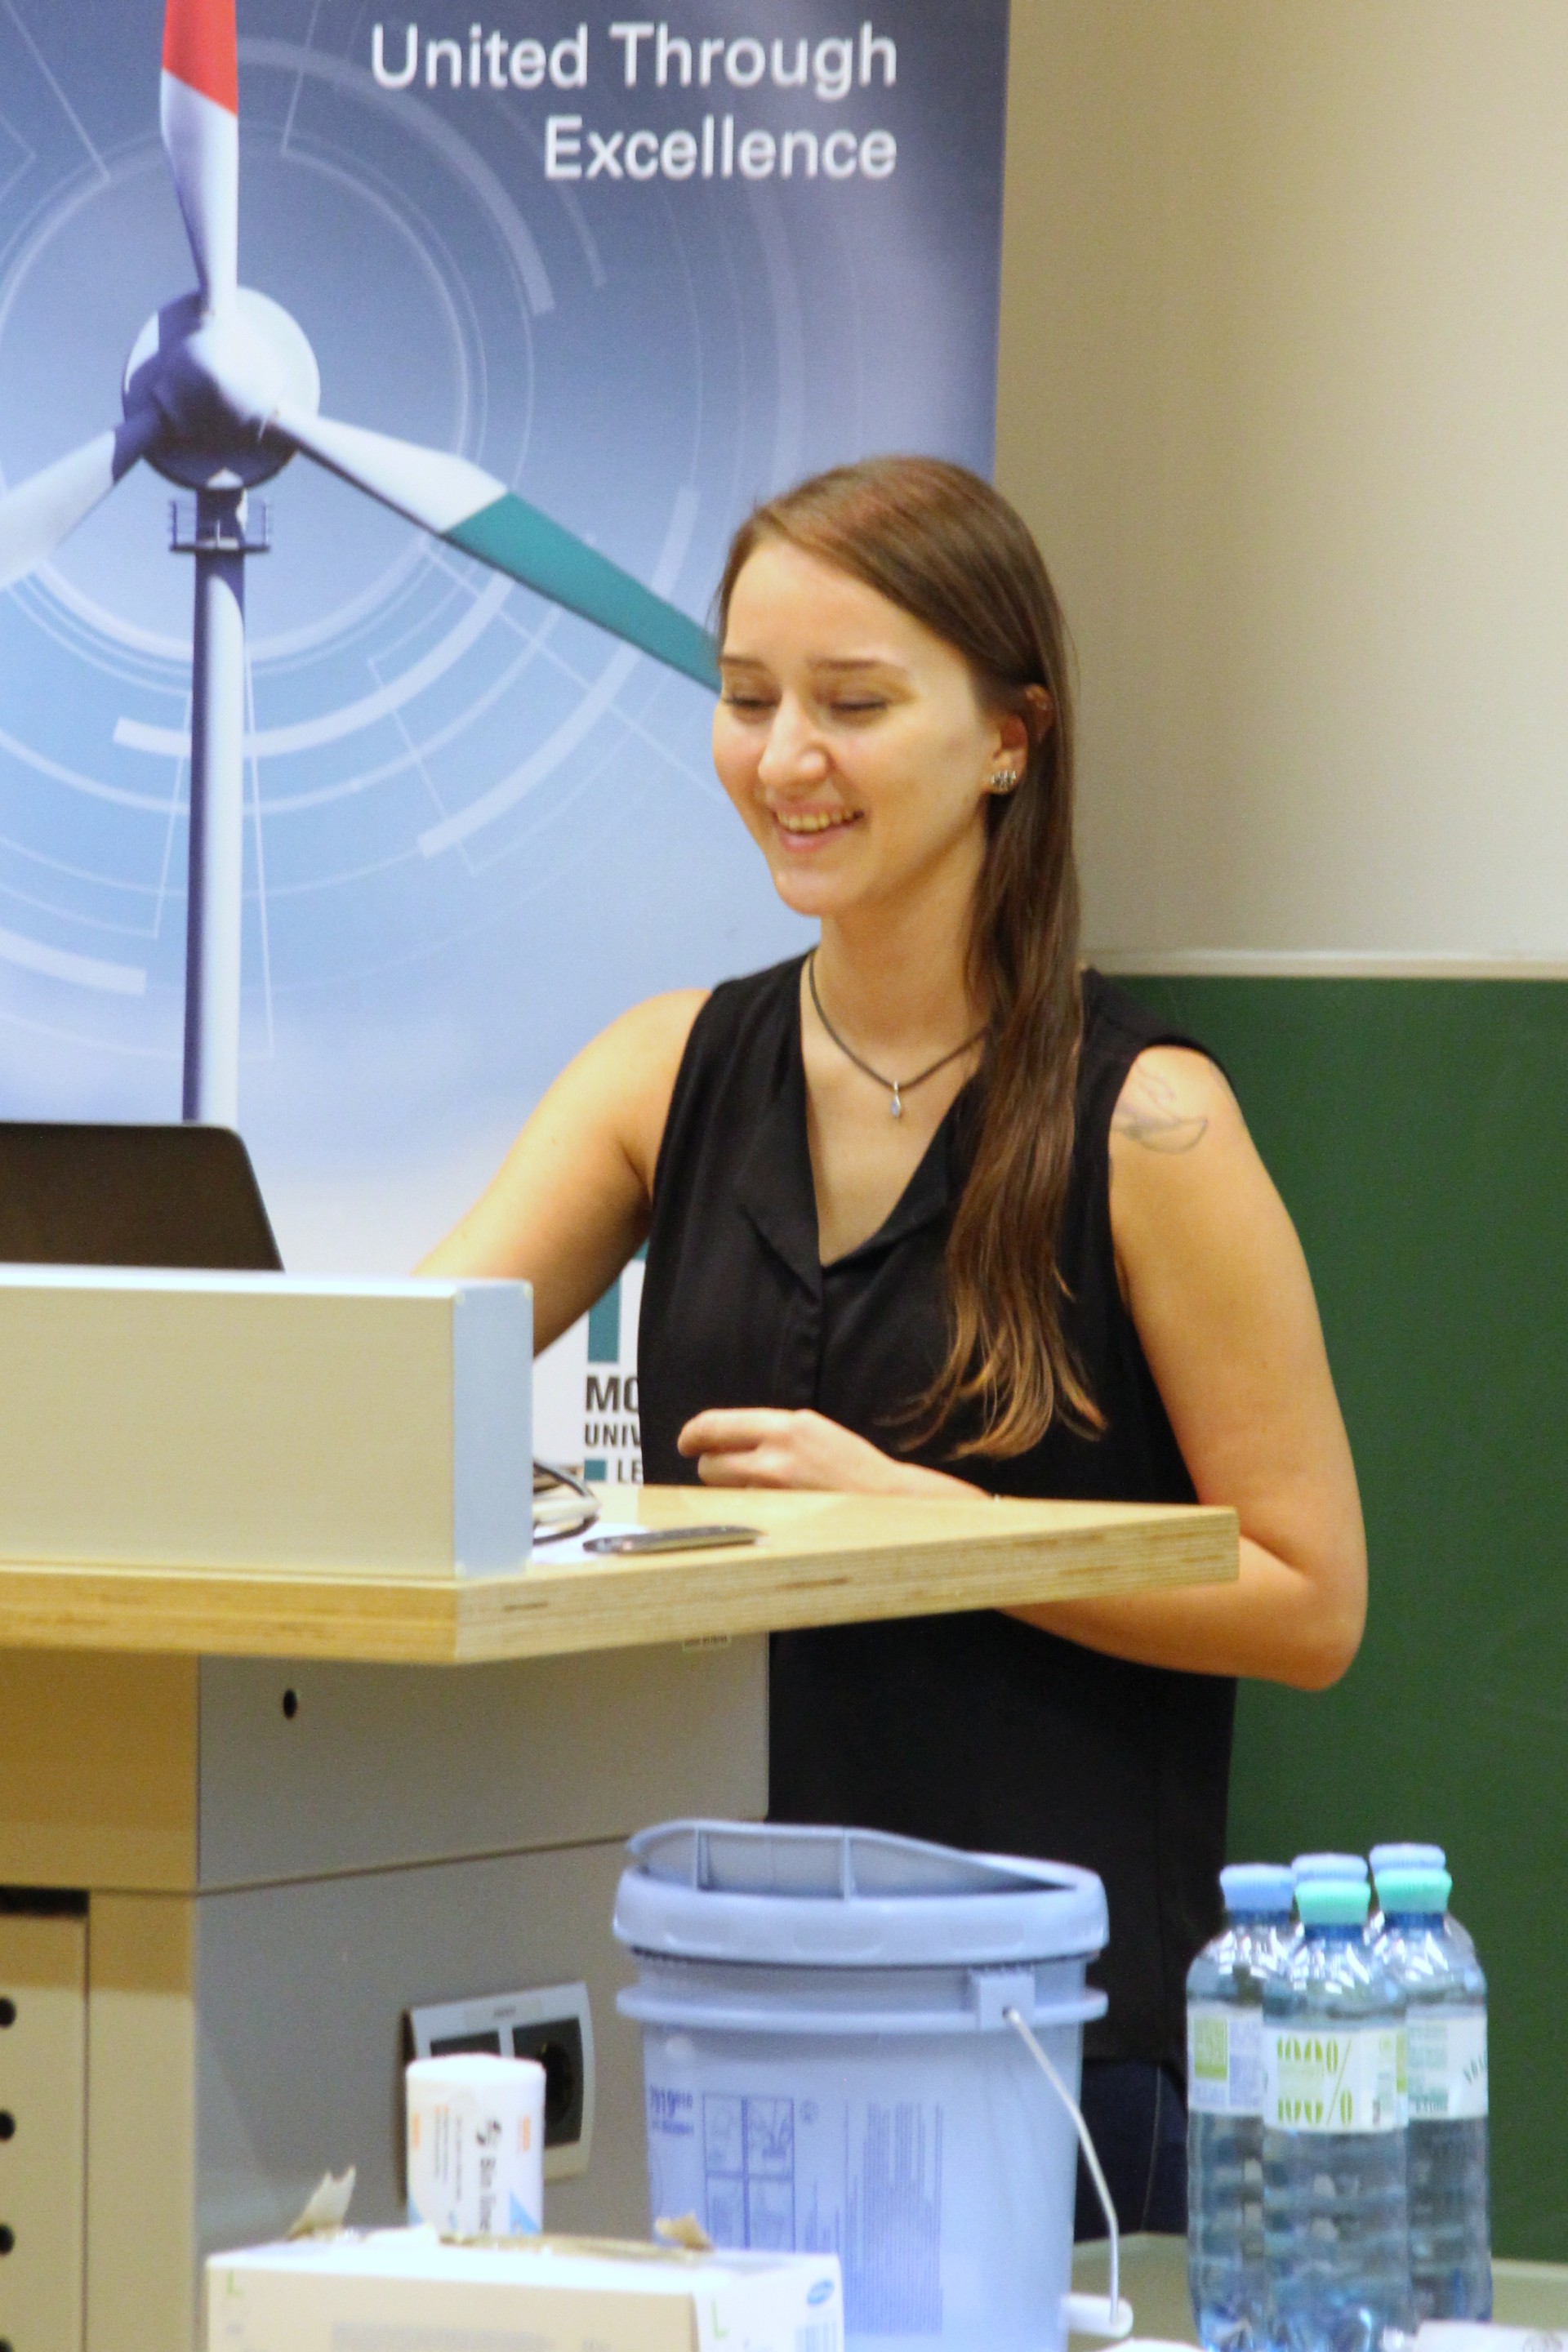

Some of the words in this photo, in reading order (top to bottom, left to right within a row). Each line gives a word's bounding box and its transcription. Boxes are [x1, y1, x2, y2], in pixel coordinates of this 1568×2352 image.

[372, 23, 588, 87] United
[609, 21, 897, 100] Through
[545, 114, 897, 179] Excellence
